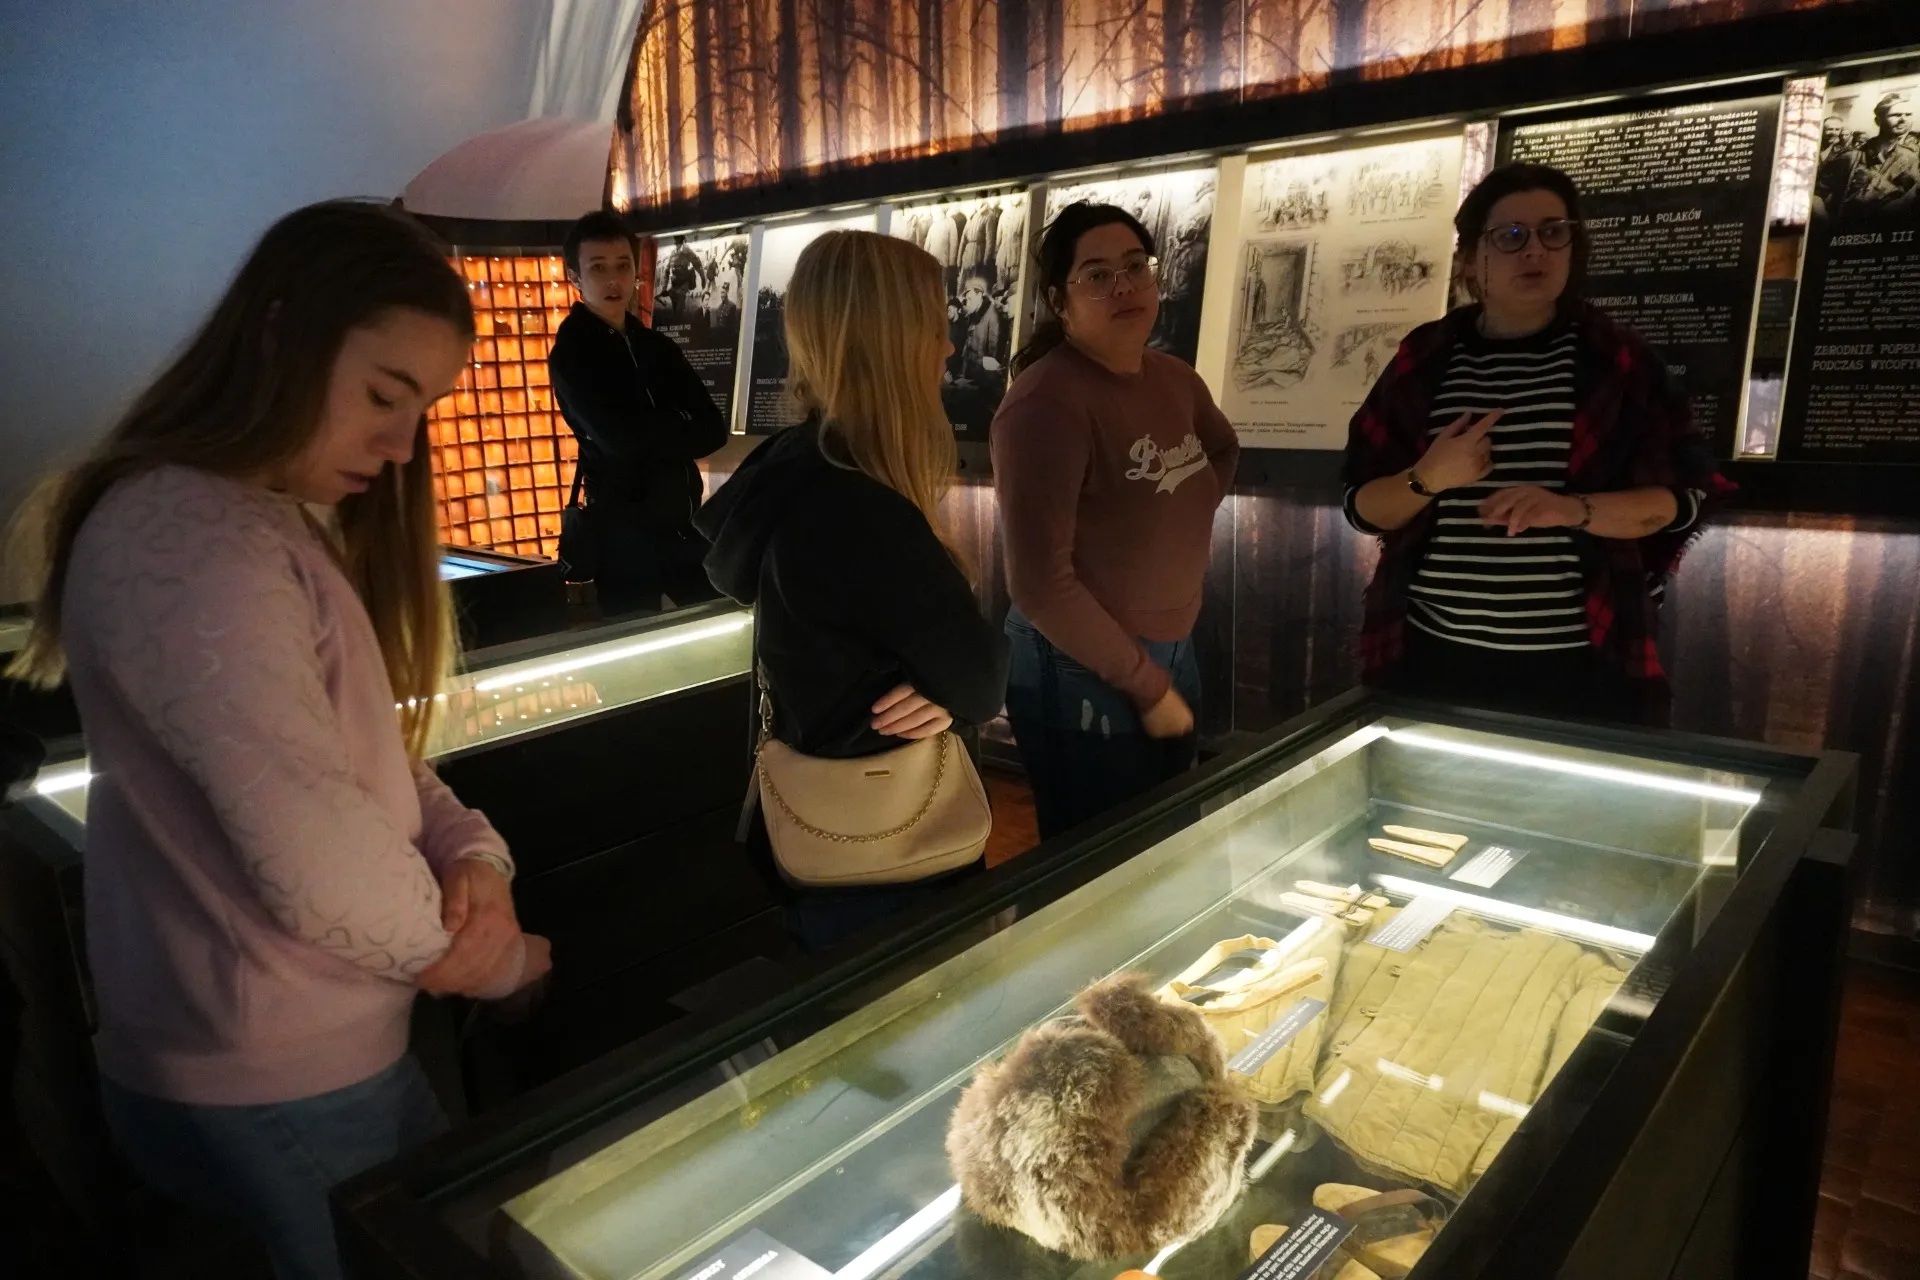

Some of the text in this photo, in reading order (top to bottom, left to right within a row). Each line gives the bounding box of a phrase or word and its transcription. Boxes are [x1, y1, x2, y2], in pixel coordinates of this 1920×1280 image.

[1568, 137, 1601, 147] Sikorski
[1715, 118, 1758, 129] ambasador
[1631, 214, 1650, 226] DLA
[1655, 210, 1702, 223] POLAKÓW
[1830, 231, 1915, 247] AGRESJA III
[1589, 293, 1696, 307] ONWENCJA WOJSKOWA
[1814, 345, 1874, 356] ZBRODNIE
[1812, 360, 1865, 371] PODCZAS
